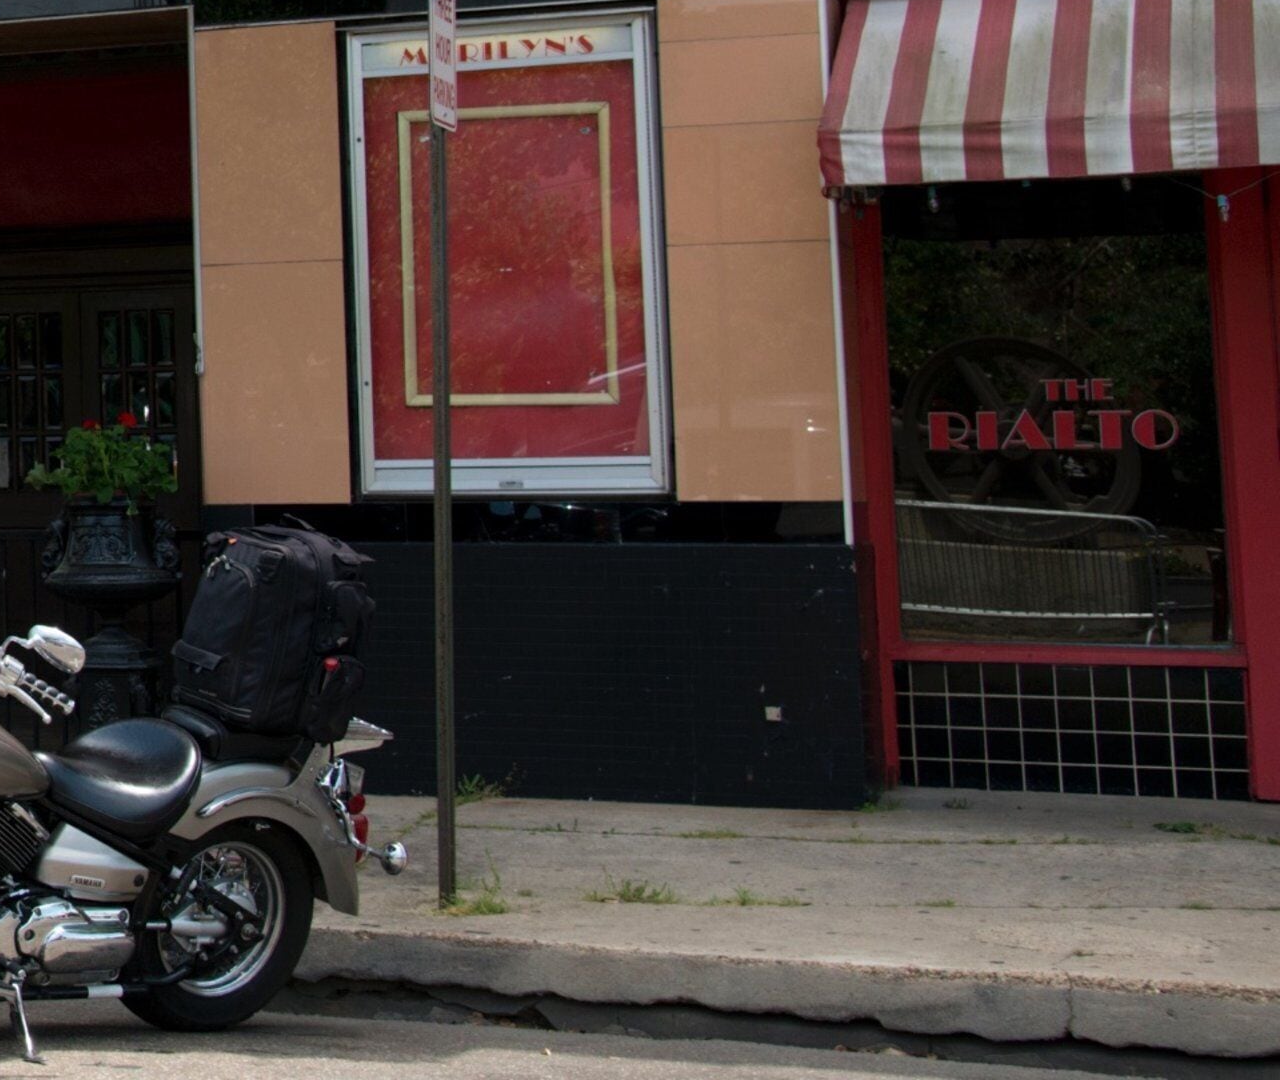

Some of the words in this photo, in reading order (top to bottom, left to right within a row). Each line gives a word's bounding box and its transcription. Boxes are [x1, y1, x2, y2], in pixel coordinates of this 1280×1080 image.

[400, 34, 594, 66] MRILYN'S
[435, 32, 452, 66] HOUR
[434, 75, 455, 110] PARKING
[1040, 378, 1114, 401] THE
[927, 409, 1179, 450] RIALTO
[74, 876, 103, 888] YAMAHA
